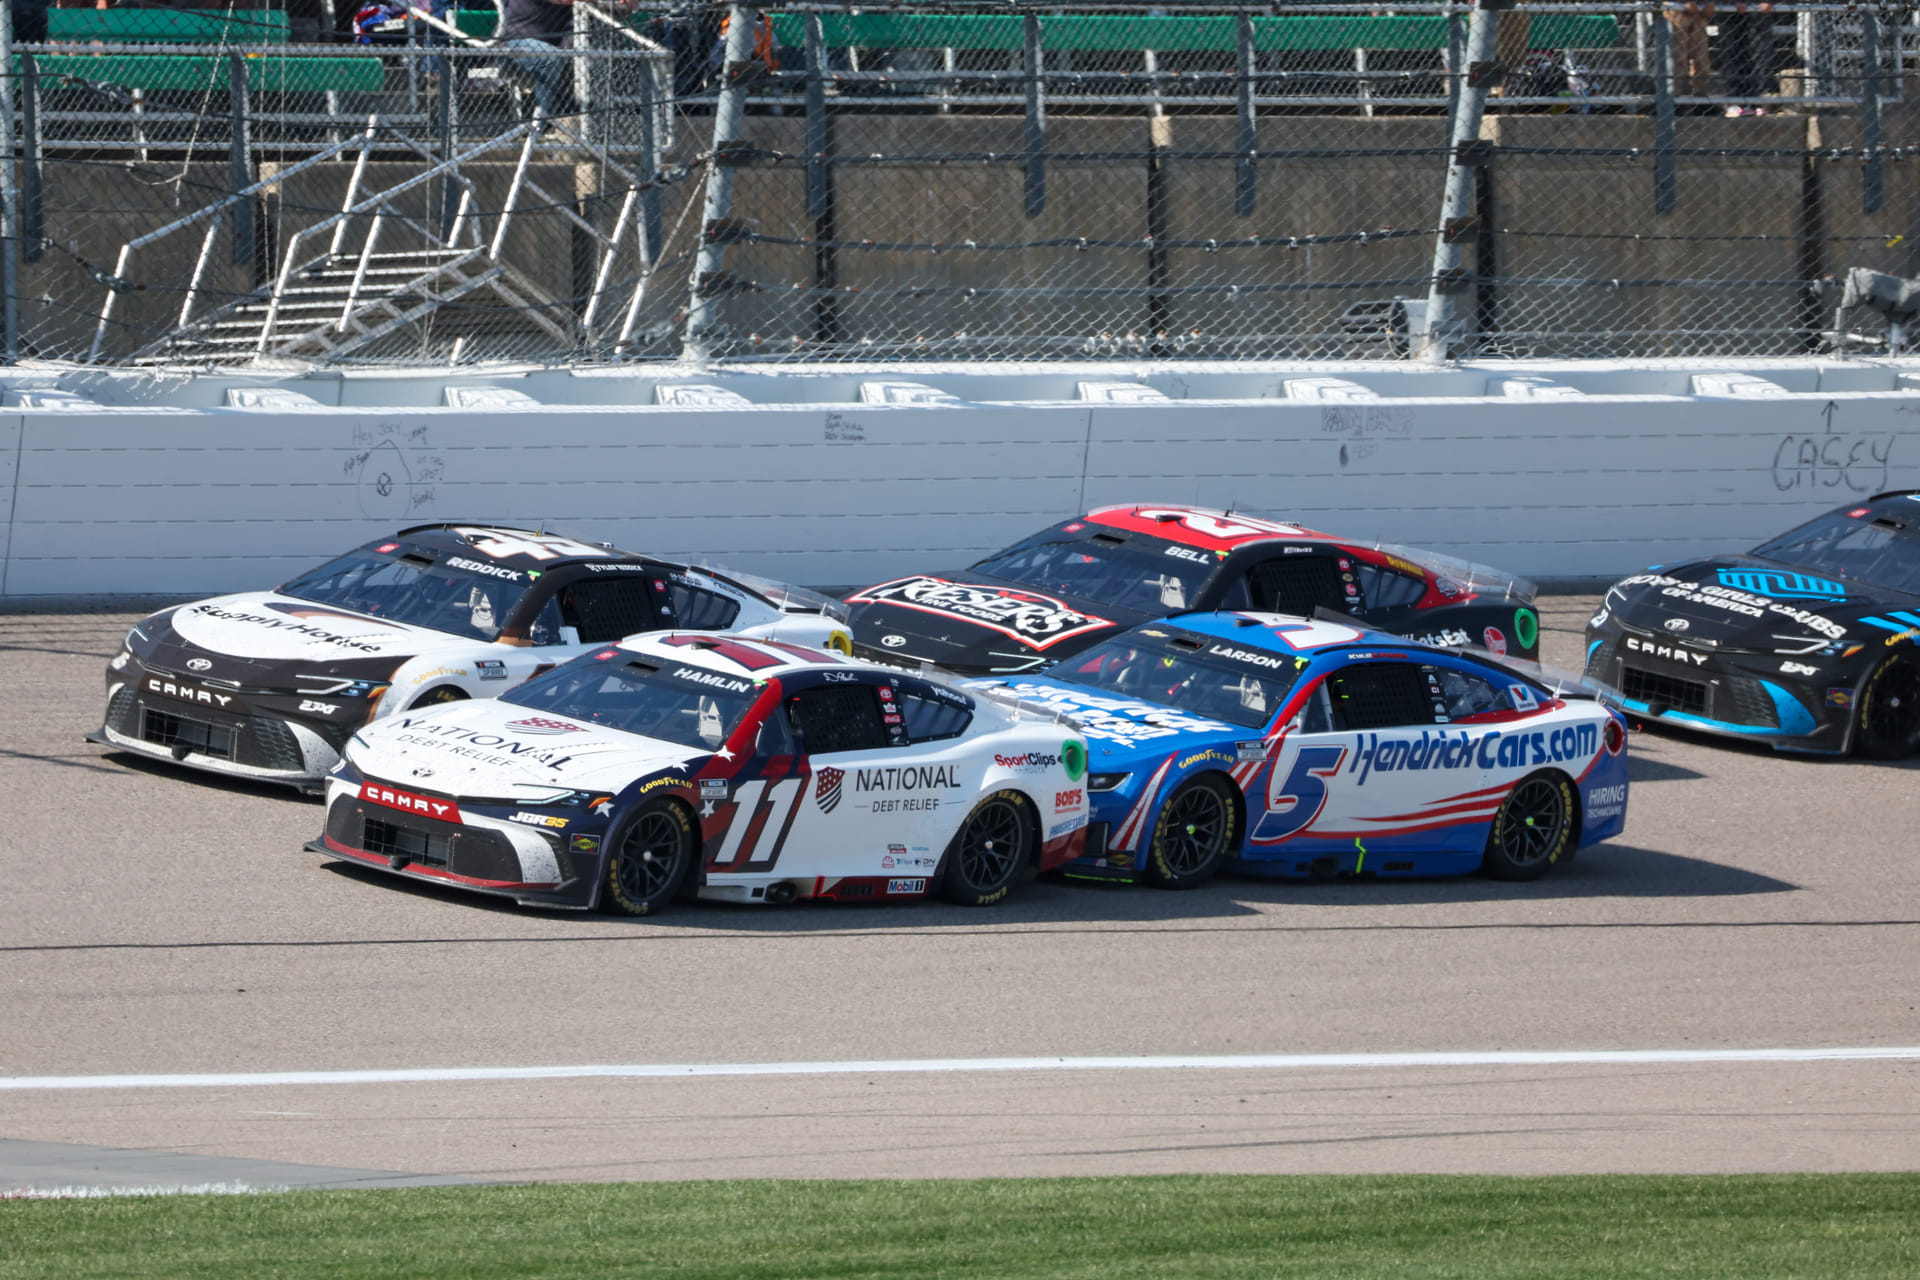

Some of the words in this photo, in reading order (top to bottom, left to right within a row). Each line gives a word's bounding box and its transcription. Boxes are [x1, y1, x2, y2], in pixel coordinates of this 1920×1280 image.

[1772, 435, 1896, 492] CASEY
[446, 556, 524, 581] REDDICK
[1164, 546, 1210, 565] BELL
[951, 603, 1007, 622] FOODS
[1686, 593, 1765, 618] AMERICA
[1700, 585, 1773, 607] GIRLS
[1769, 603, 1848, 639] CLUBS
[1209, 644, 1283, 670] LARSON
[1626, 637, 1709, 666] CAMRY
[149, 679, 232, 706] CAMRY
[673, 667, 751, 693] HAMLIN
[387, 718, 573, 772] NATIONAL
[396, 734, 451, 750] DEBT
[449, 746, 517, 768] RELIEF
[1349, 722, 1598, 786] HendrickCars.com
[1178, 749, 1235, 769] GOODYEAR
[639, 776, 693, 795] GOODYEAR
[855, 765, 961, 792] NATIONAL
[366, 786, 449, 816] CAMRY
[872, 799, 900, 813] DEBT
[902, 798, 940, 811] RELIEF
[1055, 788, 1082, 807] BOB'S
[1250, 744, 1349, 846] 5
[1588, 784, 1625, 806] HIRING
[667, 802, 690, 833] EAGLE
[713, 778, 803, 863] 11
[889, 880, 914, 892] Mobil
